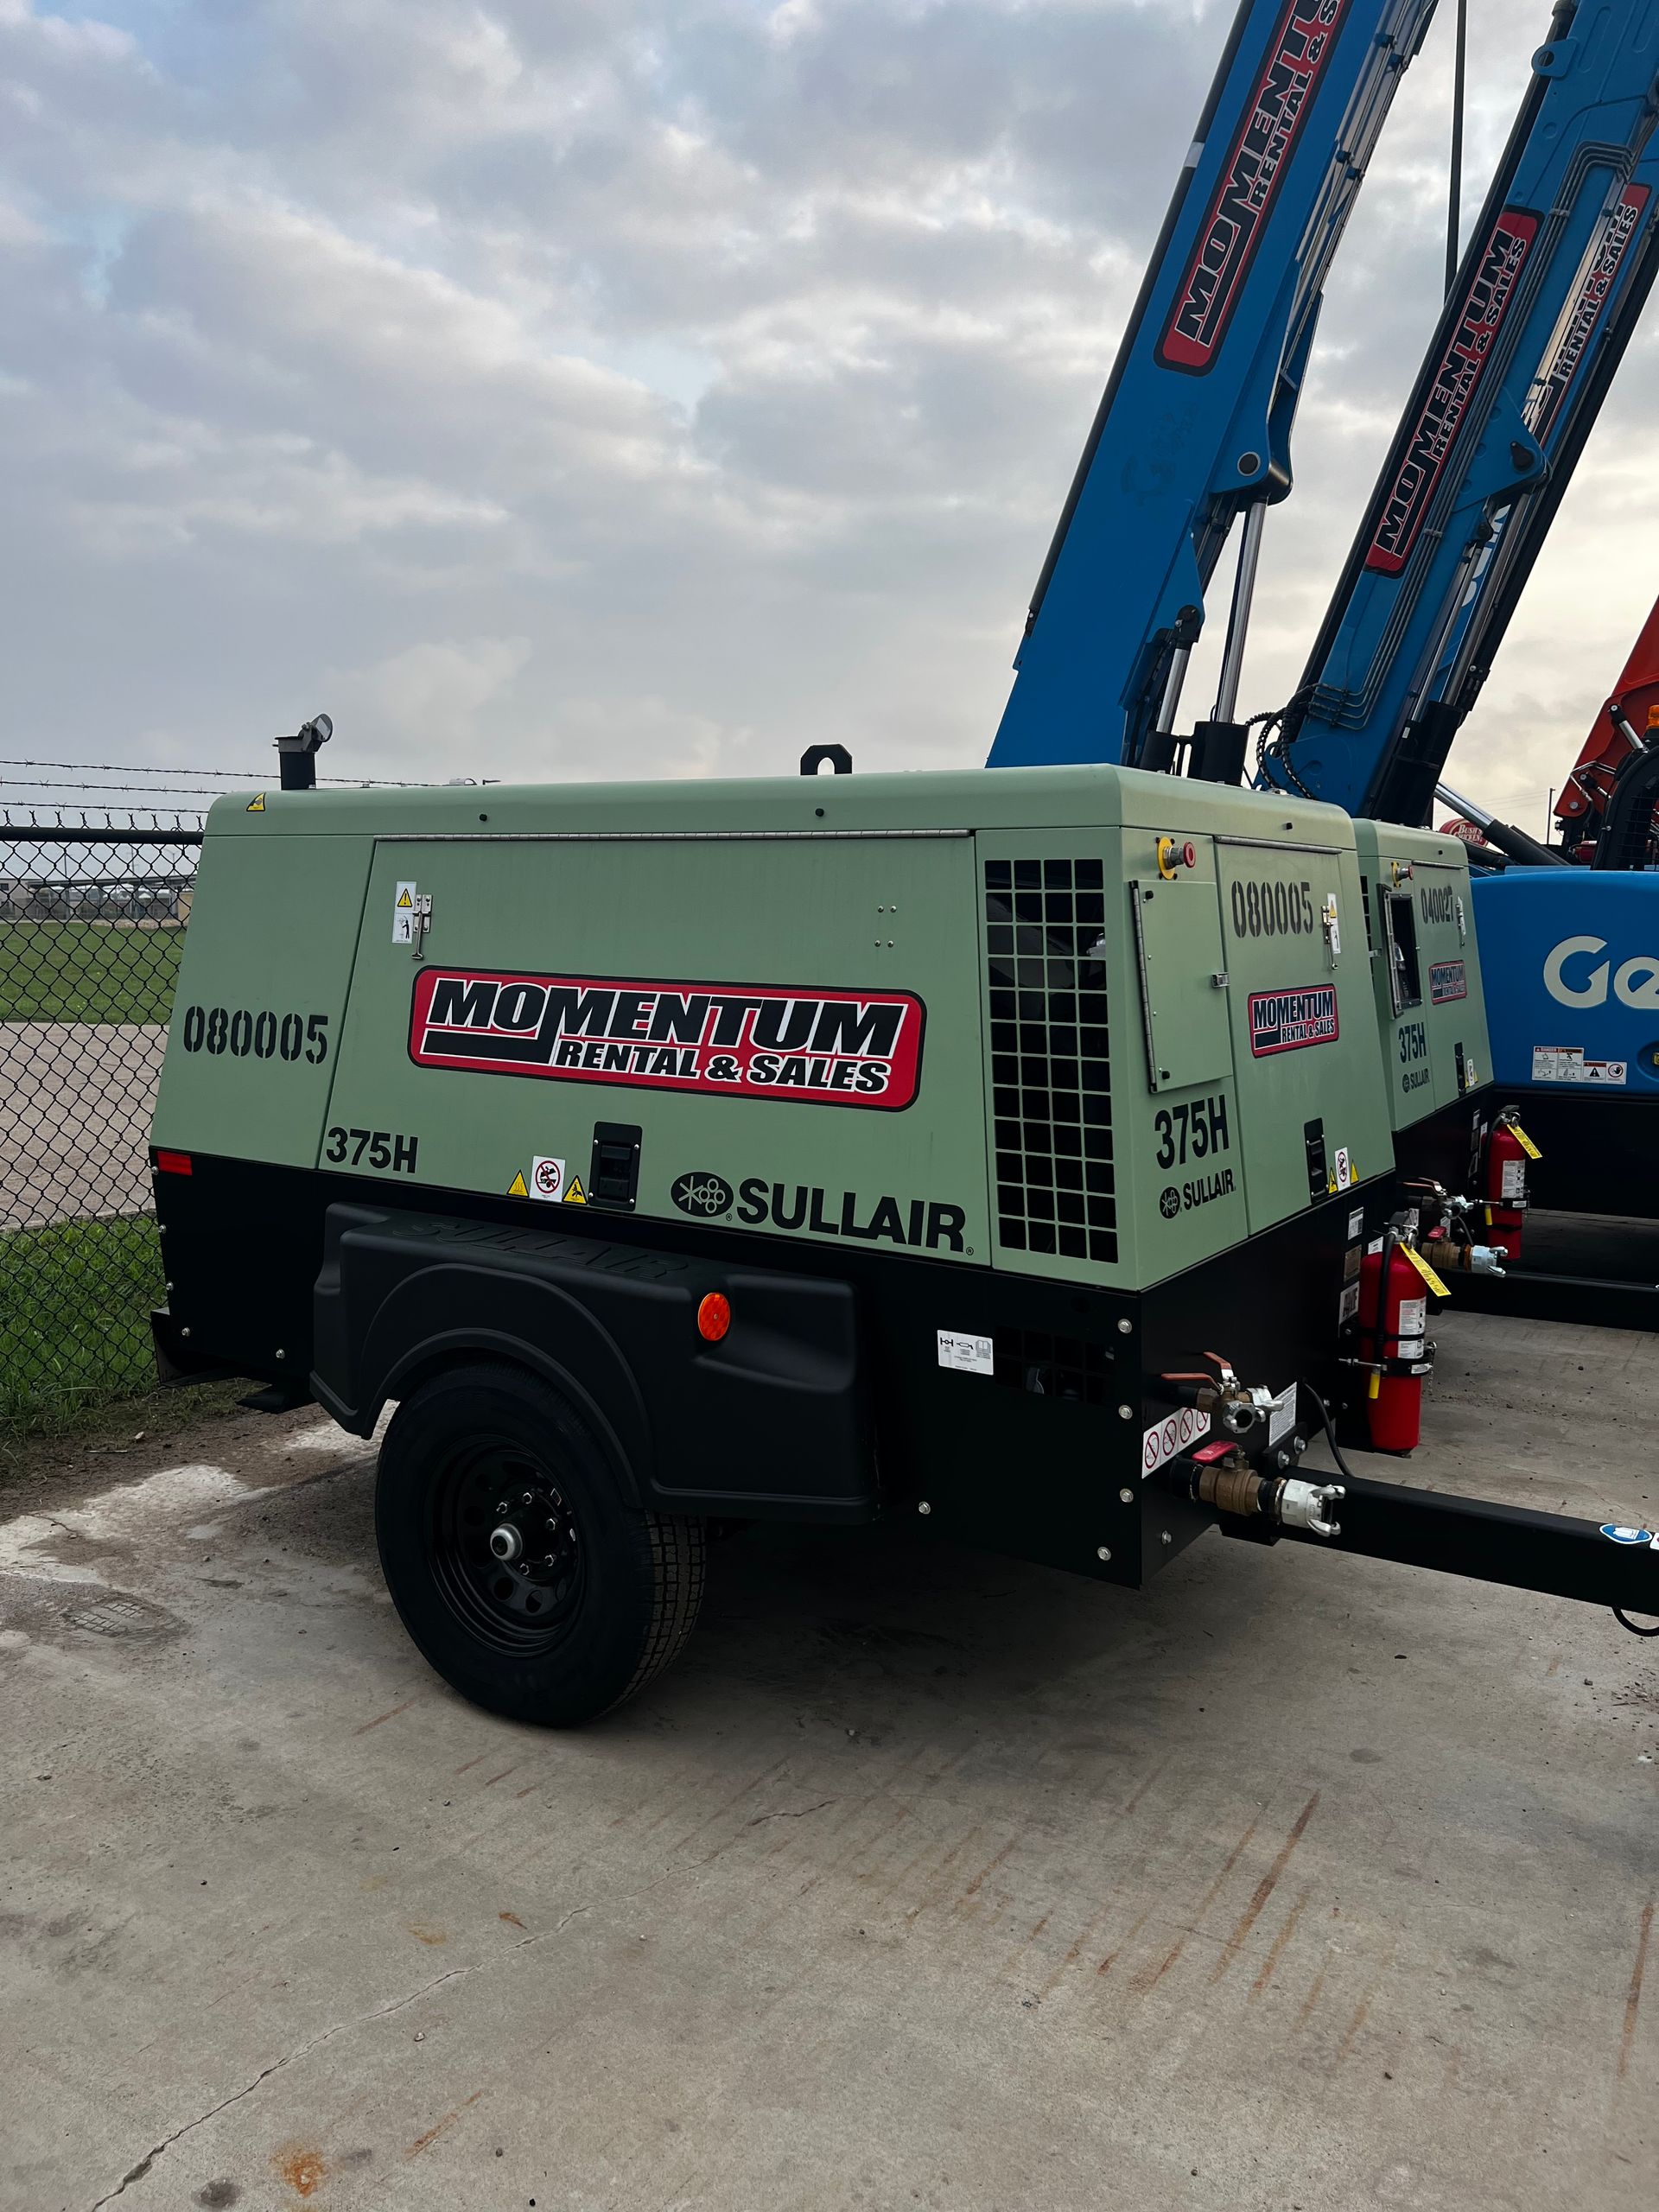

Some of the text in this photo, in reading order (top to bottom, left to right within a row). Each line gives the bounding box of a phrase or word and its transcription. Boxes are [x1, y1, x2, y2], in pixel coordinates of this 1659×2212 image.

[1249, 31, 1328, 210] RENTAL &
[1559, 205, 1637, 380] RENTAL & SALES
[1431, 237, 1526, 460] RENTAL & SALES
[1374, 227, 1514, 555] MOMENTUM
[1230, 880, 1314, 938] 080005
[183, 1006, 328, 1065] 080005
[426, 978, 908, 1058] MOMENTUM
[1252, 989, 1334, 1031] MOMENTUM
[1281, 1018, 1335, 1043] RENTAL & SALES
[553, 1038, 891, 1094] RENTAL & SALES
[1398, 1021, 1427, 1064] 375H
[326, 1127, 419, 1173] 375H
[1154, 1094, 1230, 1170] 375H
[736, 1178, 967, 1253] SULLAIR
[1183, 1168, 1234, 1211] SULLAIR
